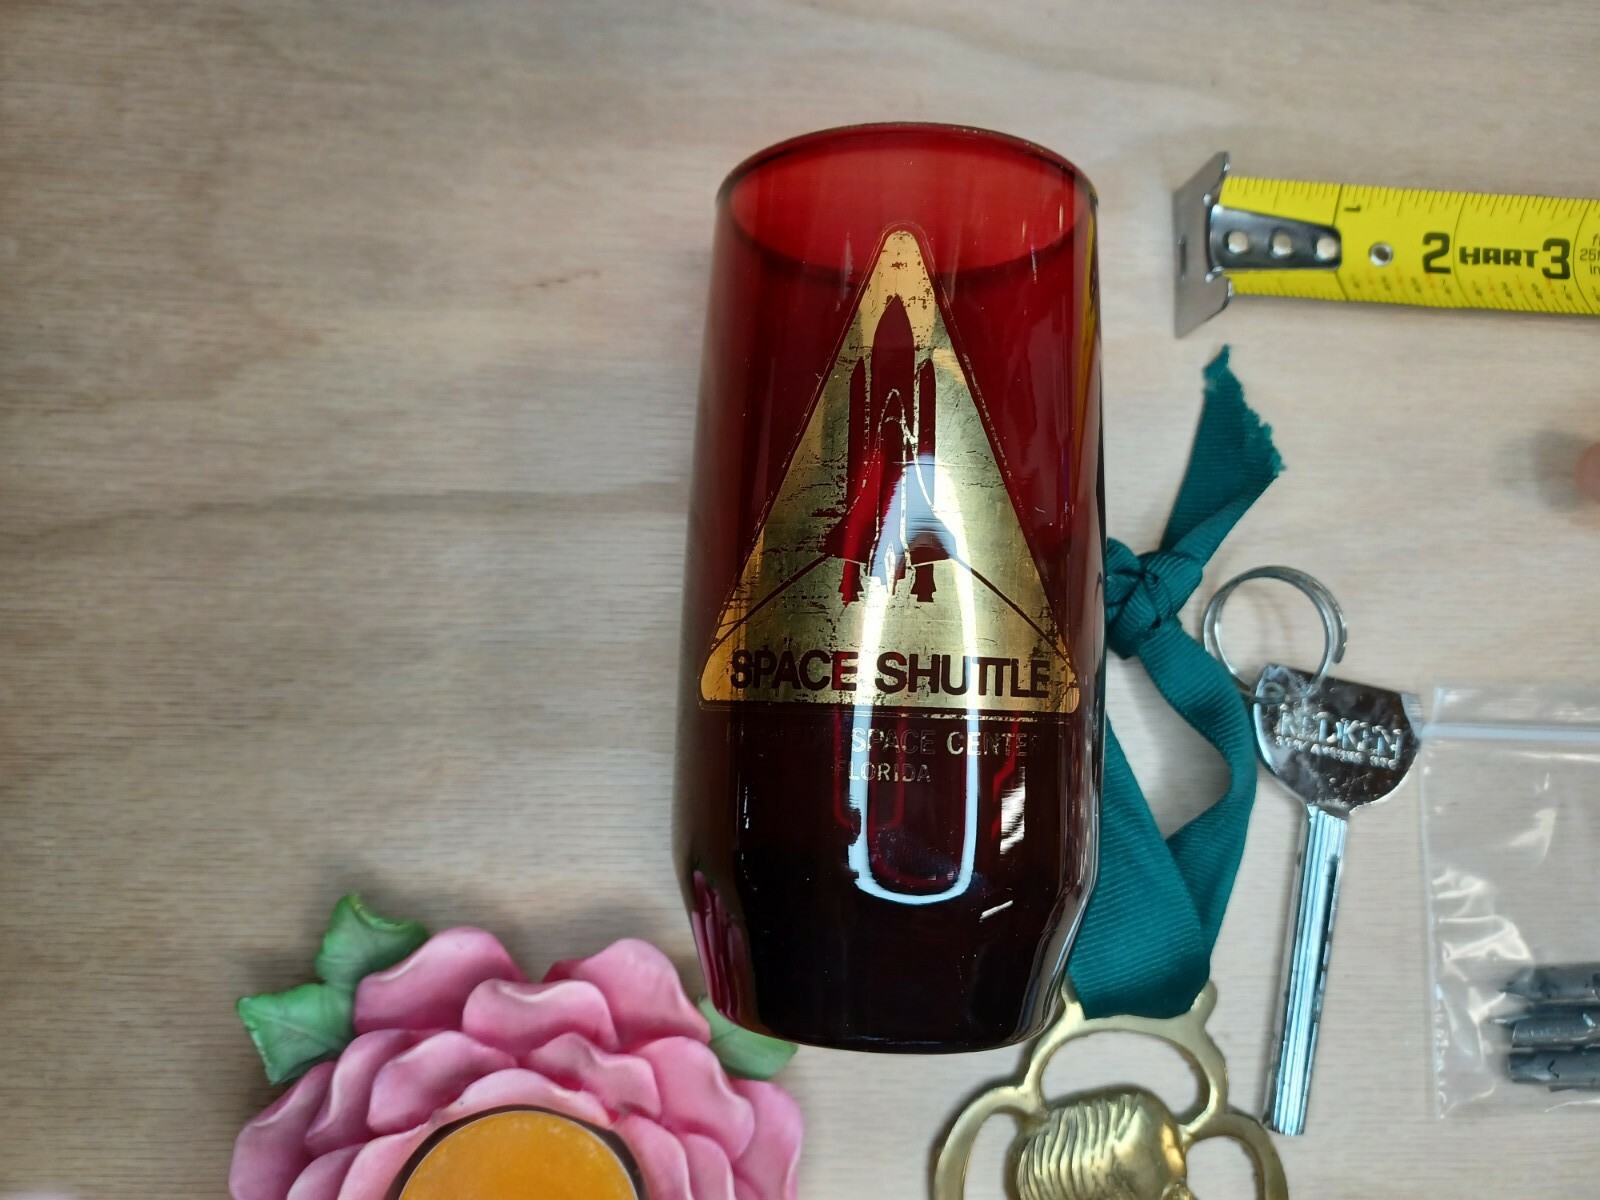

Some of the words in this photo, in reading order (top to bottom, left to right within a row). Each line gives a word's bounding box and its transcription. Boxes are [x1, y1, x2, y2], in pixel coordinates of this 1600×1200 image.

[1422, 232, 1452, 275] 2
[1459, 246, 1539, 268] HART
[1542, 237, 1571, 280] 3
[730, 649, 859, 692] SPACE
[874, 650, 1051, 698] SHUTTLE
[851, 727, 936, 755] SPACE
[834, 760, 931, 783] FLORIDA
